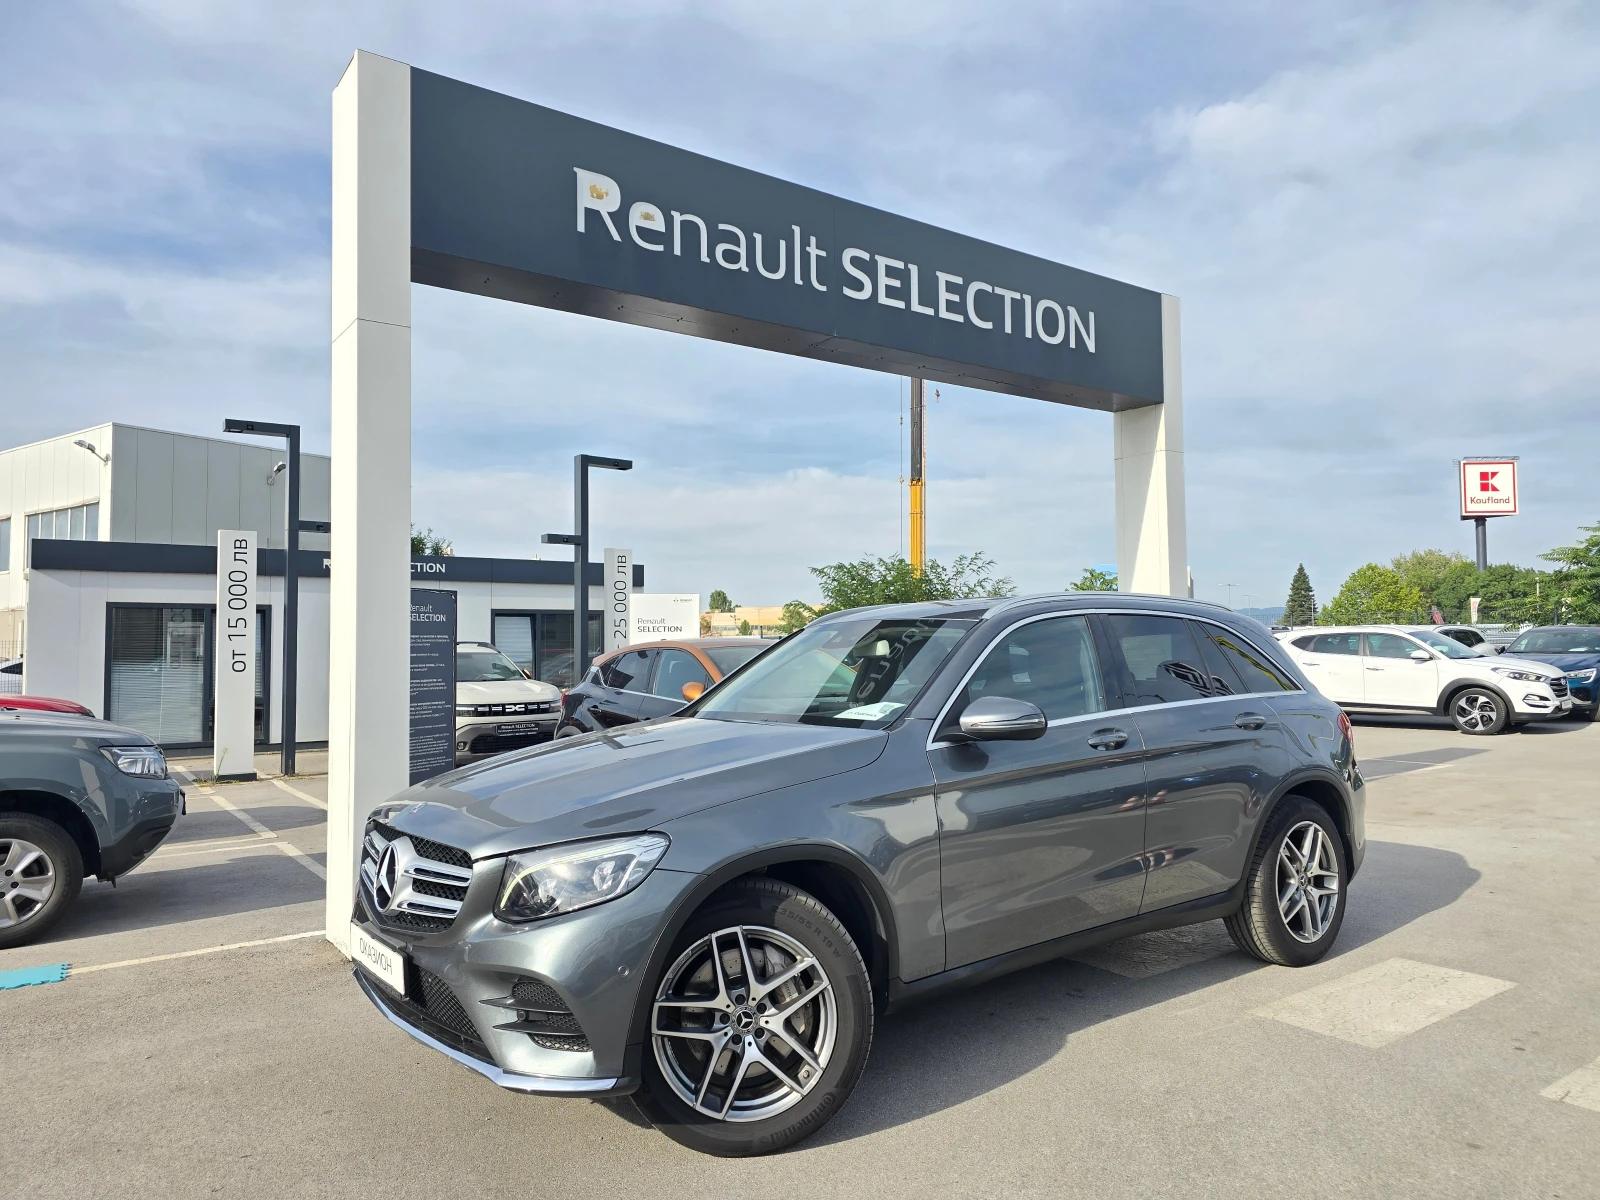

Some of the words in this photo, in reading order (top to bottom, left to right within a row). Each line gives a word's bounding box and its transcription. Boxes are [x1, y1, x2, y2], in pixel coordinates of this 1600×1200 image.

[573, 166, 827, 292] Renault
[841, 247, 1096, 354] SELECTION
[1470, 496, 1510, 504] Kaufland
[227, 570, 248, 610] 000
[613, 580, 627, 613] 000
[228, 617, 247, 642] 15
[613, 618, 627, 639] 25
[637, 617, 666, 625] Renault
[232, 649, 247, 673] от
[772, 905, 813, 930] 235/55
[813, 926, 822, 937] R
[822, 935, 834, 949] 19
[359, 937, 393, 976] ОКАЗИОН
[769, 1091, 837, 1147] Continental
